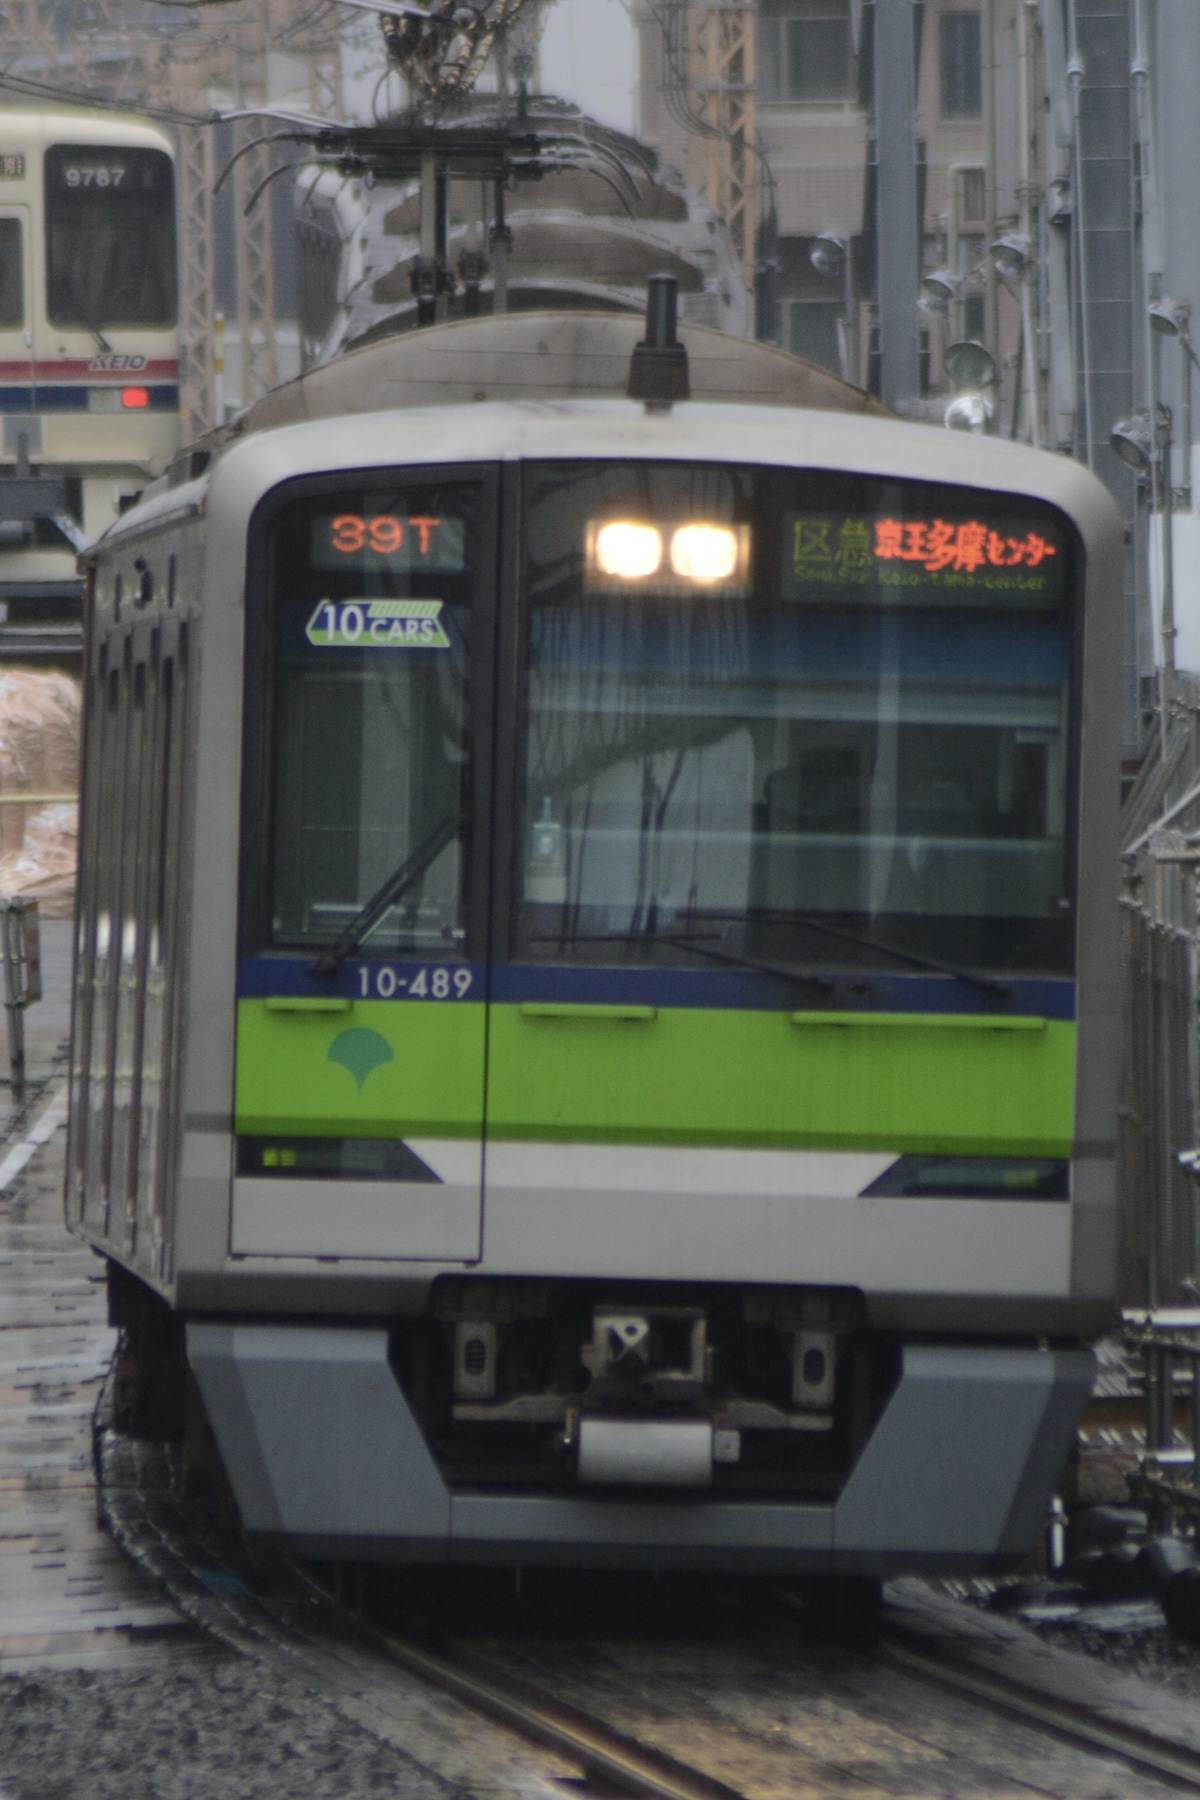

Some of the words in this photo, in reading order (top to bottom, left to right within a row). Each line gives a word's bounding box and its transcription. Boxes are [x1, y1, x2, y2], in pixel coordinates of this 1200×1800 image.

[65, 167, 125, 187] 9787
[92, 354, 146, 370] KEIO
[331, 514, 440, 555] 39T
[874, 518, 1056, 572] 京王多摩センター
[323, 604, 364, 642] 10
[369, 619, 434, 642] CARS
[359, 966, 473, 999] 10-489
